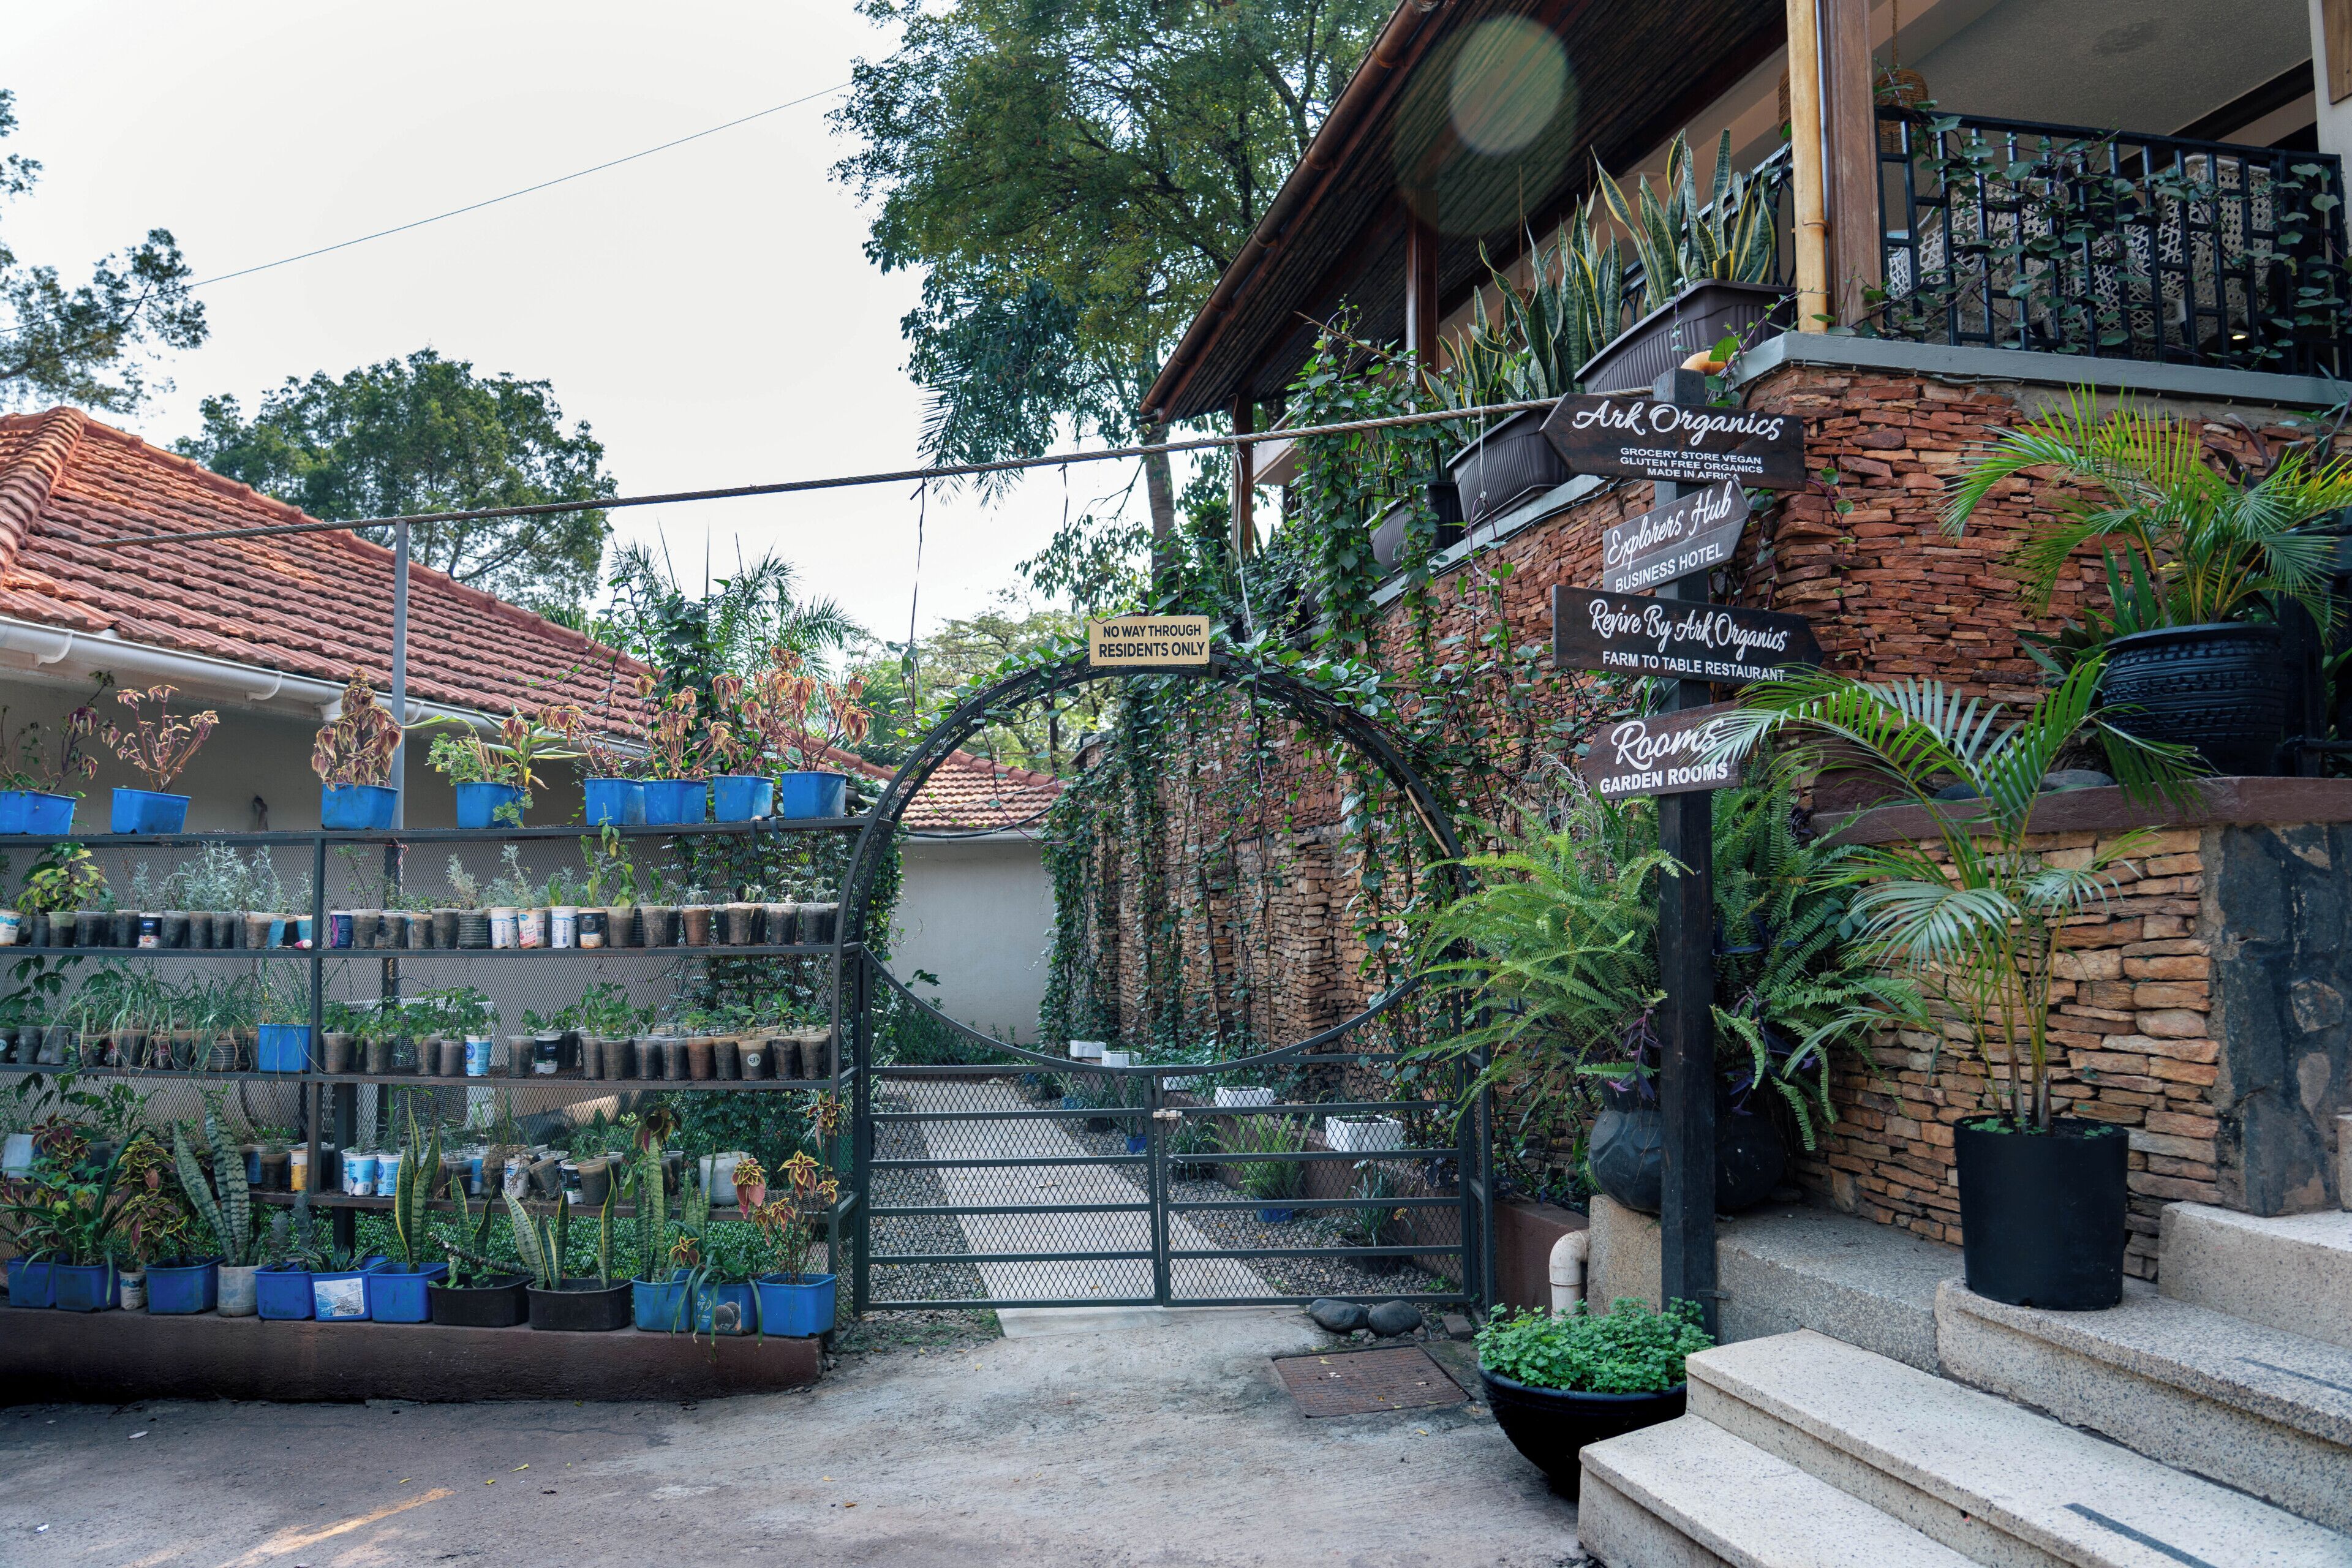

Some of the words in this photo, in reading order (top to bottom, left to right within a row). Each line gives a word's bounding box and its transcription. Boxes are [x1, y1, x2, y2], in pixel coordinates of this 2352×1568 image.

[1572, 400, 1646, 435] Ark
[1649, 404, 1784, 447] Organics
[1620, 448, 1678, 458] GROCERY
[1681, 451, 1719, 461] STORE
[1722, 454, 1761, 465] VEGAN
[1620, 457, 1668, 467] GLUTEN
[1671, 461, 1701, 469] FREE
[1704, 462, 1763, 473] ORGANICS
[1647, 468, 1681, 478] MADE
[1607, 510, 1684, 571] Explorers
[1688, 480, 1733, 536] Hub
[1615, 559, 1675, 593] BUSINESS
[1679, 543, 1723, 571] HOTEL
[1103, 626, 1120, 638] NO
[1121, 625, 1146, 637] WAY
[1148, 624, 1201, 636] THROUGH
[1589, 598, 1642, 639] Revive
[1643, 605, 1672, 653] By
[1674, 609, 1714, 649] Ark
[1714, 613, 1788, 662] Organics
[1099, 643, 1168, 658] RESIDENTS
[1172, 642, 1205, 656] ONLY
[1603, 650, 1638, 667] FARM
[1642, 655, 1659, 669] TO
[1662, 657, 1702, 673] TABLE
[1705, 661, 1785, 682] RESTAURANT
[1611, 718, 1724, 771] Rooms
[1600, 770, 1663, 794] GARDEN
[1668, 762, 1728, 785] ROOMS
